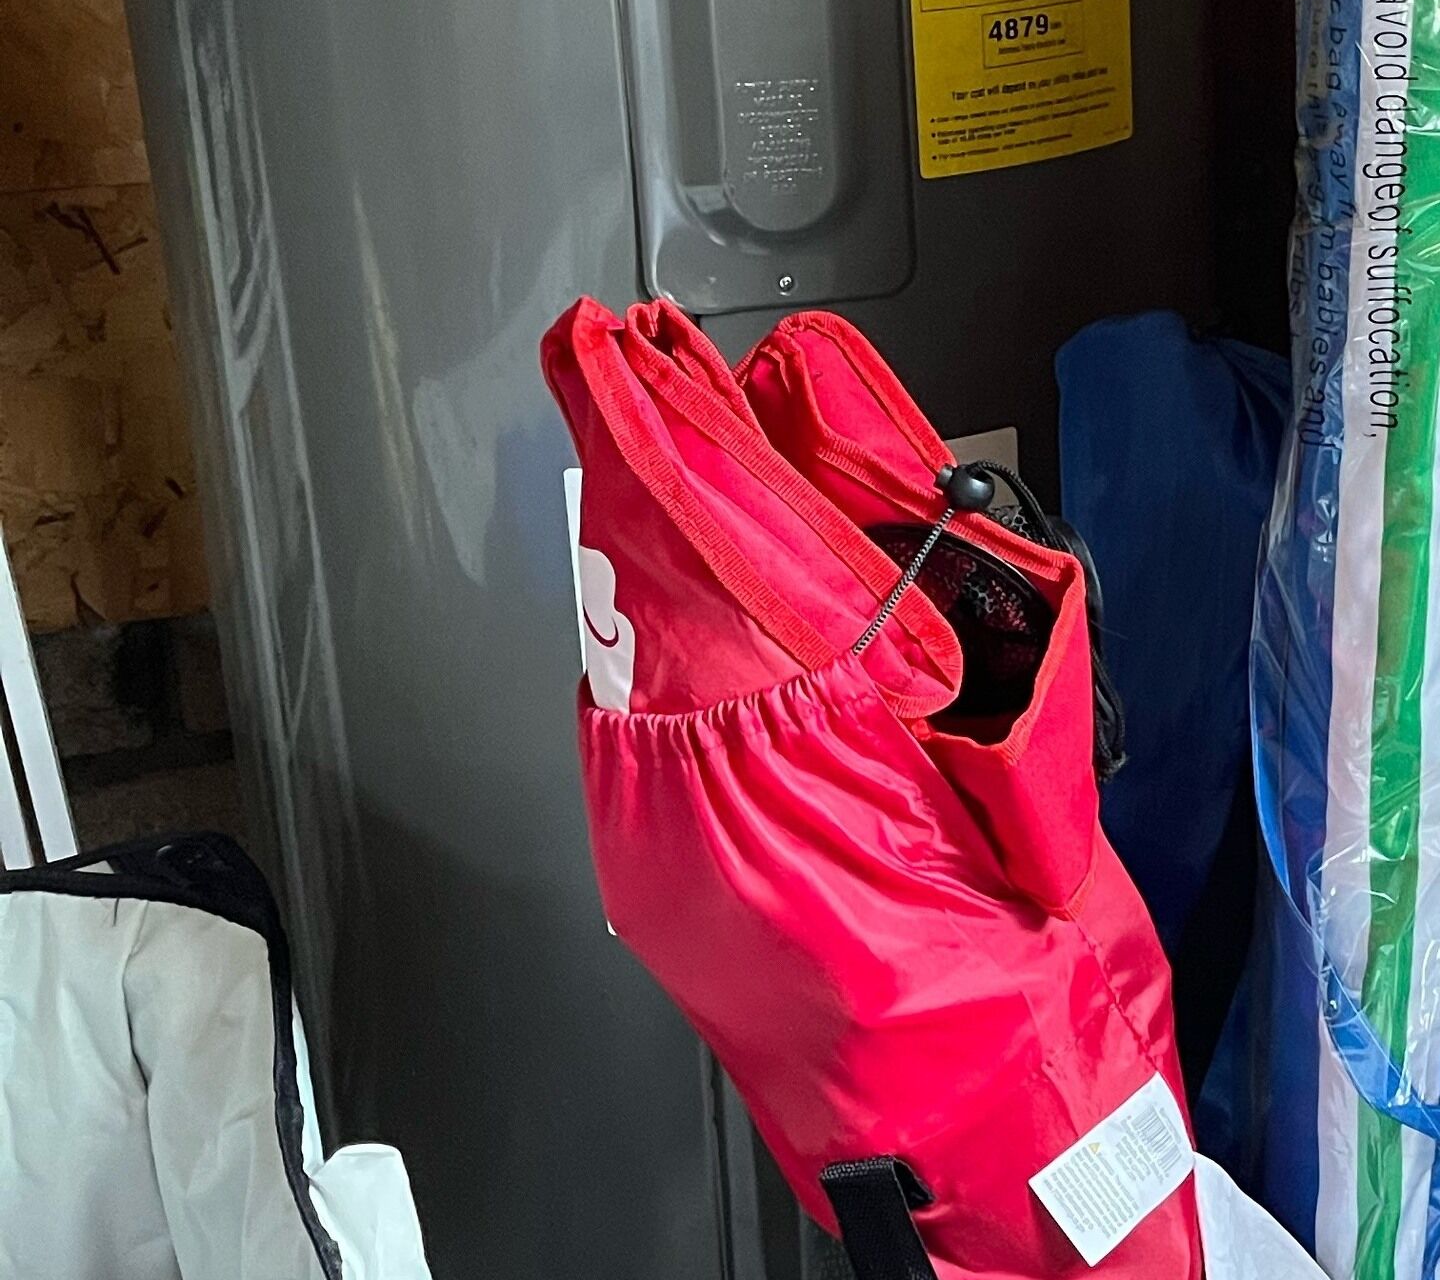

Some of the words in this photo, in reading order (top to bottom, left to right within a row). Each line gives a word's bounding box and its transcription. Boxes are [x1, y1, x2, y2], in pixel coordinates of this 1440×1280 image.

[989, 14, 1049, 42] 4879
[1326, 26, 1347, 91] bag
[1362, 94, 1418, 201] dange
[1367, 205, 1413, 235] of
[1310, 263, 1341, 375] babies
[1362, 245, 1412, 437] suffocation,
[1299, 385, 1338, 448] and
